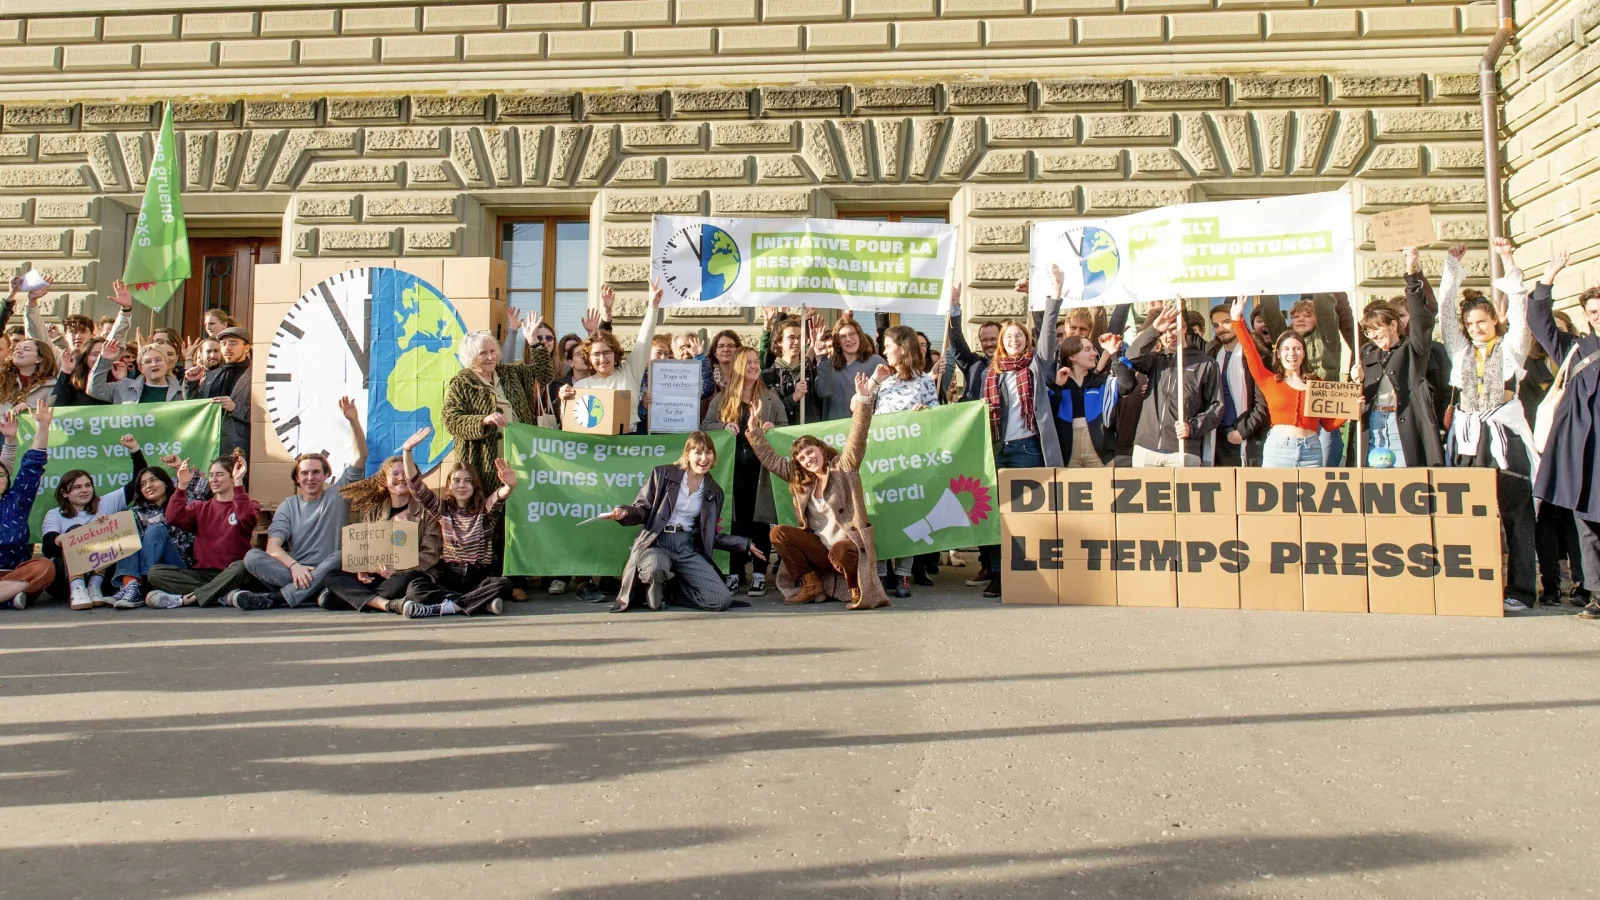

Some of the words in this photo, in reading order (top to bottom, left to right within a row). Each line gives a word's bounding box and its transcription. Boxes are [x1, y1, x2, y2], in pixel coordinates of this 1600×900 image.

[150, 165, 175, 224] gruene
[756, 235, 850, 251] INITIATIVE
[855, 239, 904, 253] POUR
[909, 242, 932, 255] LA
[756, 255, 905, 274] RESPONSABILITÉ
[755, 277, 938, 296] ENVIRONNEMENTALE
[1311, 381, 1360, 391] ZUEKUNFT
[1311, 389, 1328, 398] WÄR
[1311, 398, 1351, 415] GEIL
[89, 413, 155, 436] gruene
[47, 444, 98, 460] eunes
[529, 437, 589, 461] junge
[593, 444, 666, 462] gruene
[528, 469, 598, 490] jeunes
[873, 483, 925, 504] verdi
[1010, 479, 1094, 512] DIE
[1110, 478, 1221, 513] ZEIT
[1245, 471, 1488, 517] DRÄNGT.
[349, 528, 386, 541] RESPECT
[88, 543, 124, 570] geil!
[347, 553, 400, 567] BOUNDARIES
[1010, 535, 1064, 572] LE
[1080, 539, 1251, 574] TEMPS
[1270, 541, 1495, 581] PRESSE.
